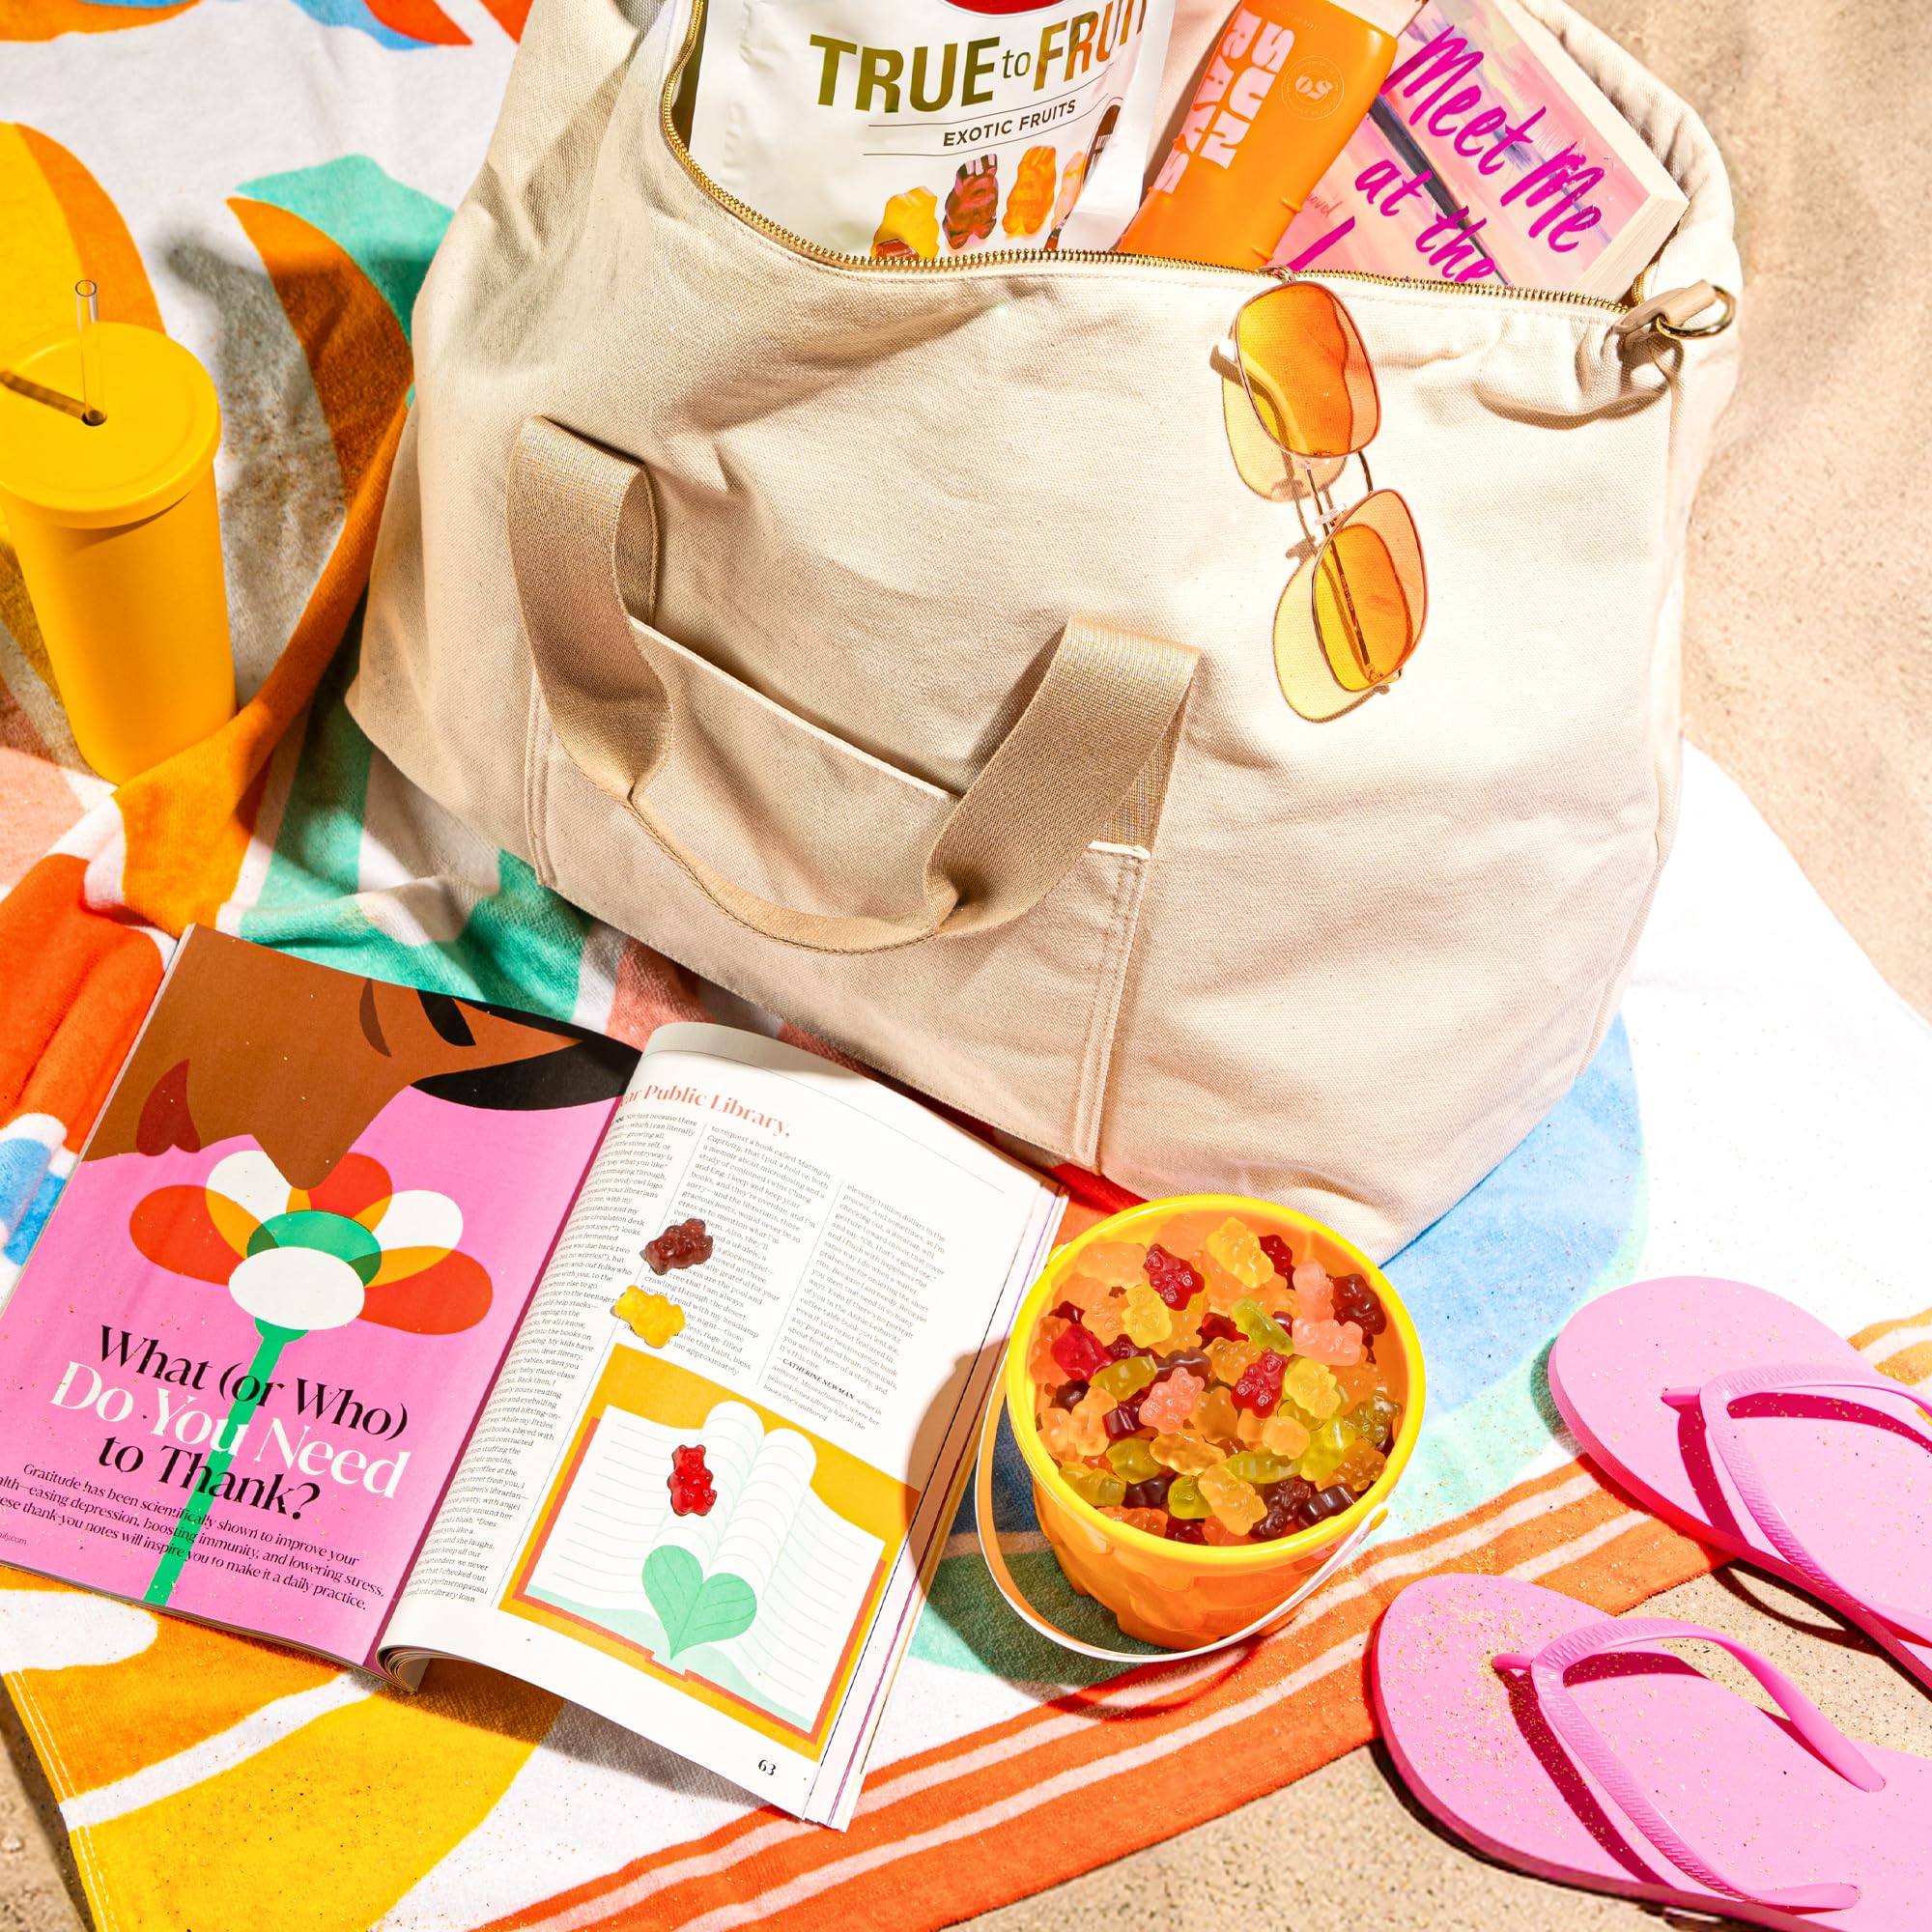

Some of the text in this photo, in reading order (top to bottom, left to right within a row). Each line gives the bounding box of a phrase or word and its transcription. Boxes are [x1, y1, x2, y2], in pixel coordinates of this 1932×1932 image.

[809, 34, 1002, 113] TRUE
[1003, 48, 1032, 82] to
[1200, 21, 1294, 169] SUN
[942, 99, 1076, 147] EXOTIC FRUITS
[1378, 25, 1605, 253] Meet Me
[1355, 158, 1433, 216] at
[1416, 206, 1496, 282] the
[643, 1084, 706, 1106] Public
[710, 1094, 790, 1138] Library,
[697, 1152, 721, 1166] study
[728, 1164, 766, 1182] conjoined
[766, 1178, 787, 1192] twins
[787, 1187, 811, 1204] Chang
[707, 1146, 737, 1159] memoir
[736, 1155, 759, 1169] about
[759, 1165, 806, 1190] microdosing
[805, 1185, 820, 1196] and
[720, 1128, 749, 1143] request
[753, 1140, 773, 1152] book
[773, 1150, 797, 1163] called
[796, 1158, 823, 1176] Mating
[822, 1171, 831, 1179] in
[743, 1147, 760, 1158] that
[763, 1155, 778, 1165] put
[782, 1163, 801, 1176] hold
[800, 1172, 810, 1180] on
[810, 1175, 829, 1189] both
[685, 1180, 728, 1200] sorry—and
[727, 1195, 742, 1206] the
[779, 1217, 800, 1232] those
[694, 1162, 710, 1172] and
[730, 1173, 750, 1187] keep
[749, 1182, 765, 1192] and
[763, 1186, 782, 1202] keep
[781, 1197, 800, 1209] your
[715, 1180, 731, 1190] and
[730, 1185, 757, 1200] they're
[788, 1211, 805, 1222] and
[804, 1217, 815, 1229] I'm
[677, 1200, 697, 1210] crass
[706, 1208, 717, 1217] to
[716, 1212, 748, 1230] mention
[748, 1226, 767, 1238] what
[767, 1233, 779, 1244] I'm
[680, 1190, 714, 1206] gracious
[738, 1210, 761, 1224] would
[760, 1220, 781, 1234] never
[781, 1229, 792, 1238] be
[100, 1325, 408, 1440] What (or Who)
[50, 1361, 411, 1498] Do You Need
[99, 1435, 320, 1520] to Thank?
[23, 1463, 359, 1565] Gratitude has been scientifically shown to improve your
[22, 1501, 83, 1528] thank-you
[85, 1522, 118, 1538] notes
[122, 1532, 143, 1546] will
[143, 1537, 185, 1557] inspire
[185, 1550, 209, 1564] you
[211, 1556, 224, 1567] to
[225, 1561, 261, 1577] make
[262, 1568, 270, 1579] it
[271, 1574, 280, 1582] a
[282, 1574, 308, 1592] daily
[312, 1584, 365, 1609] practice.
[70, 1497, 139, 1526] depression,
[143, 1518, 198, 1544] boosting
[198, 1532, 258, 1559] immunity,
[262, 1551, 288, 1565] and
[288, 1555, 343, 1582] lowering
[344, 1575, 383, 1597] stress.
[758, 1759, 777, 1776] 63
